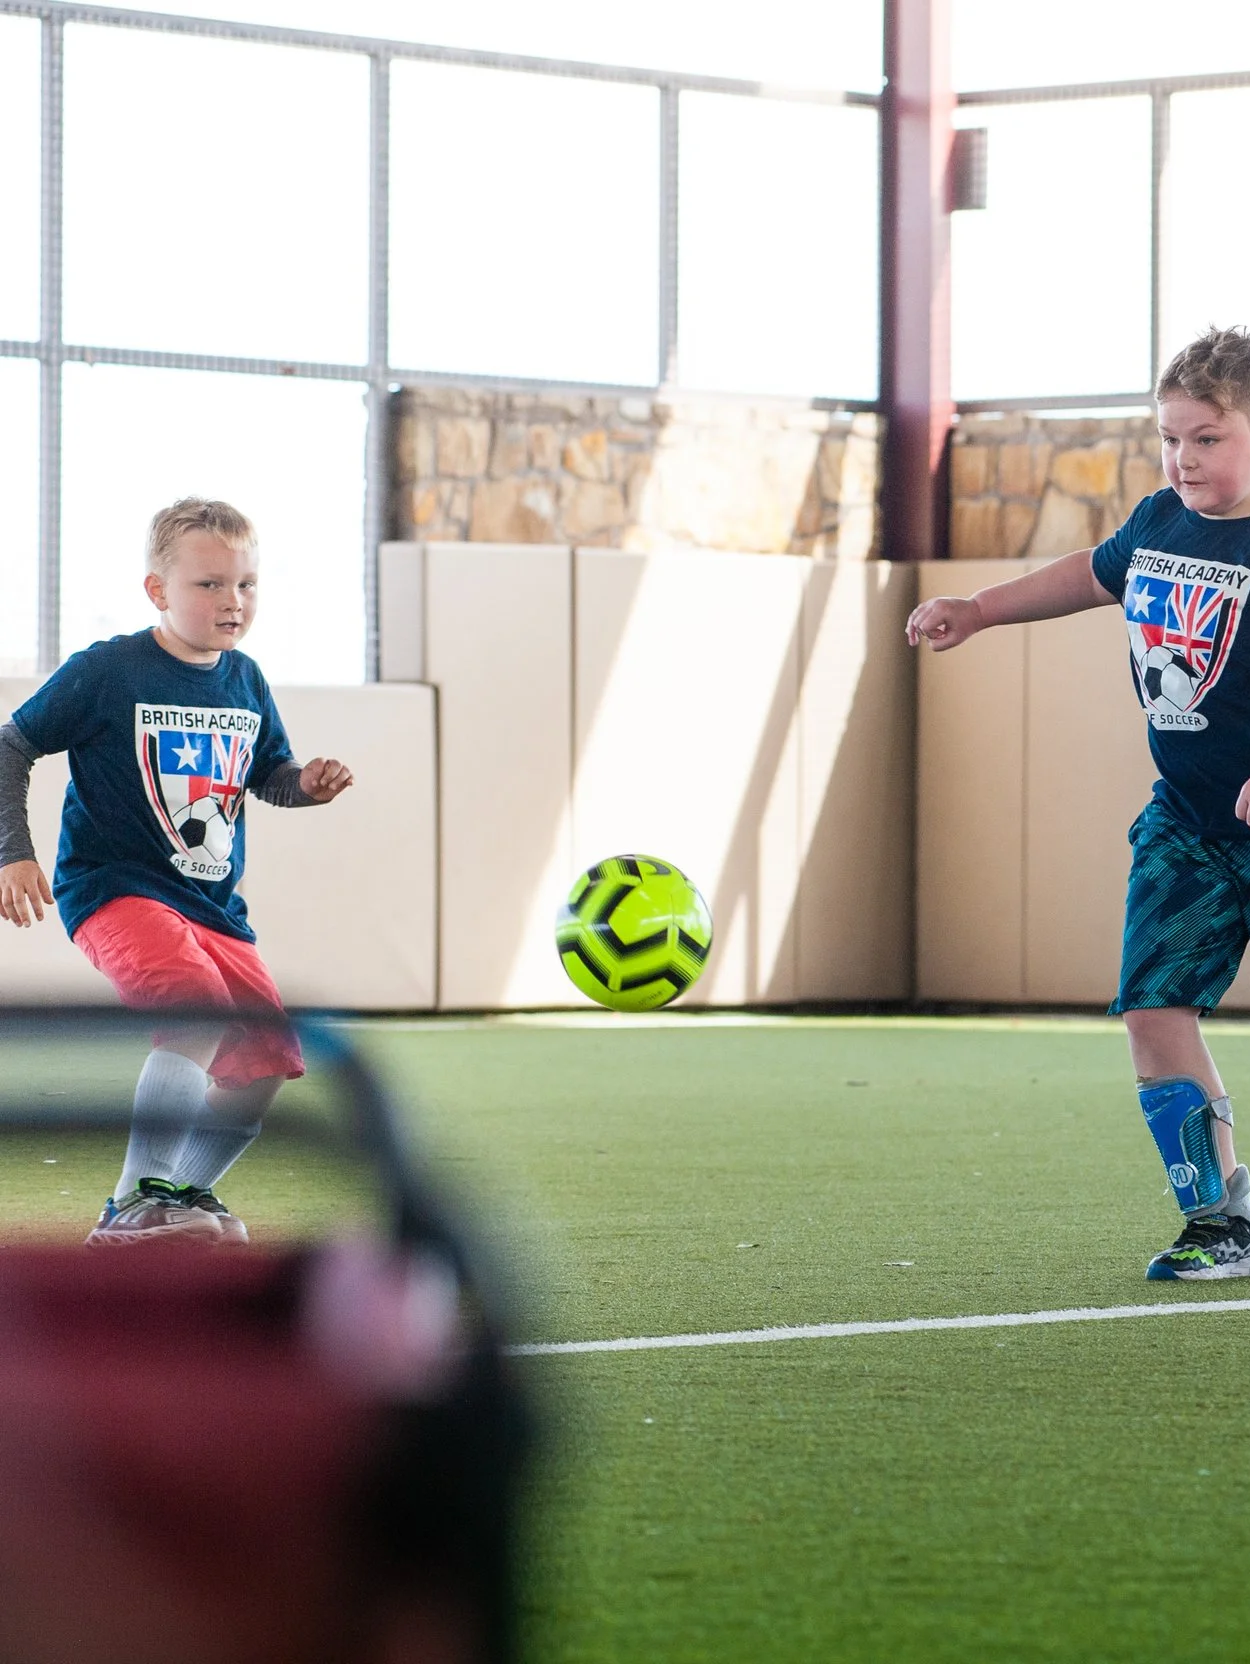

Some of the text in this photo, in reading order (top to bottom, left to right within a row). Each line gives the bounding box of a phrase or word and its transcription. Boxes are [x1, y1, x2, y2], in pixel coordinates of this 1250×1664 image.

[1129, 554, 1249, 590] BRITISH ACADEMY
[142, 710, 204, 728] BRITISH
[1160, 714, 1203, 726] SOCCER
[174, 859, 228, 875] OF SOCCER
[1170, 1167, 1189, 1185] 90
